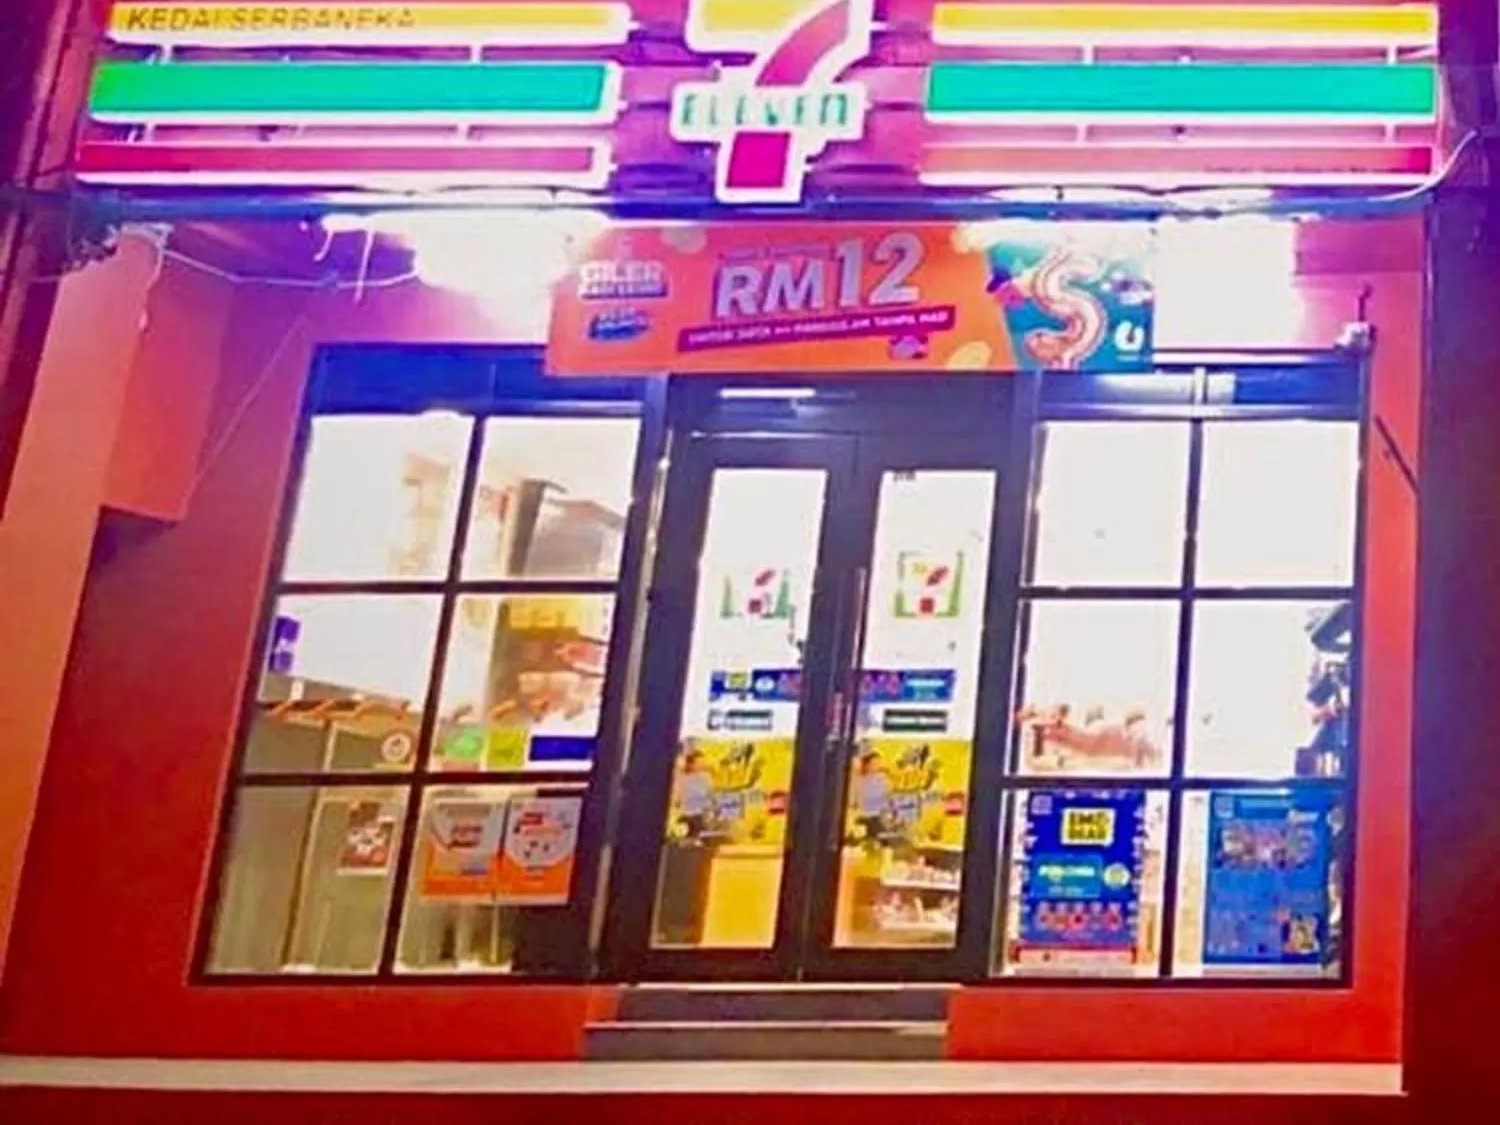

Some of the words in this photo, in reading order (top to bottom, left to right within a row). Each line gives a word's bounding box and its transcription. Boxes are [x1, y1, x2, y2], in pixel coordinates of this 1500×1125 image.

[127, 7, 224, 32] KEDAI
[229, 6, 417, 31] SERBANEKA
[715, 233, 925, 317] RM12
